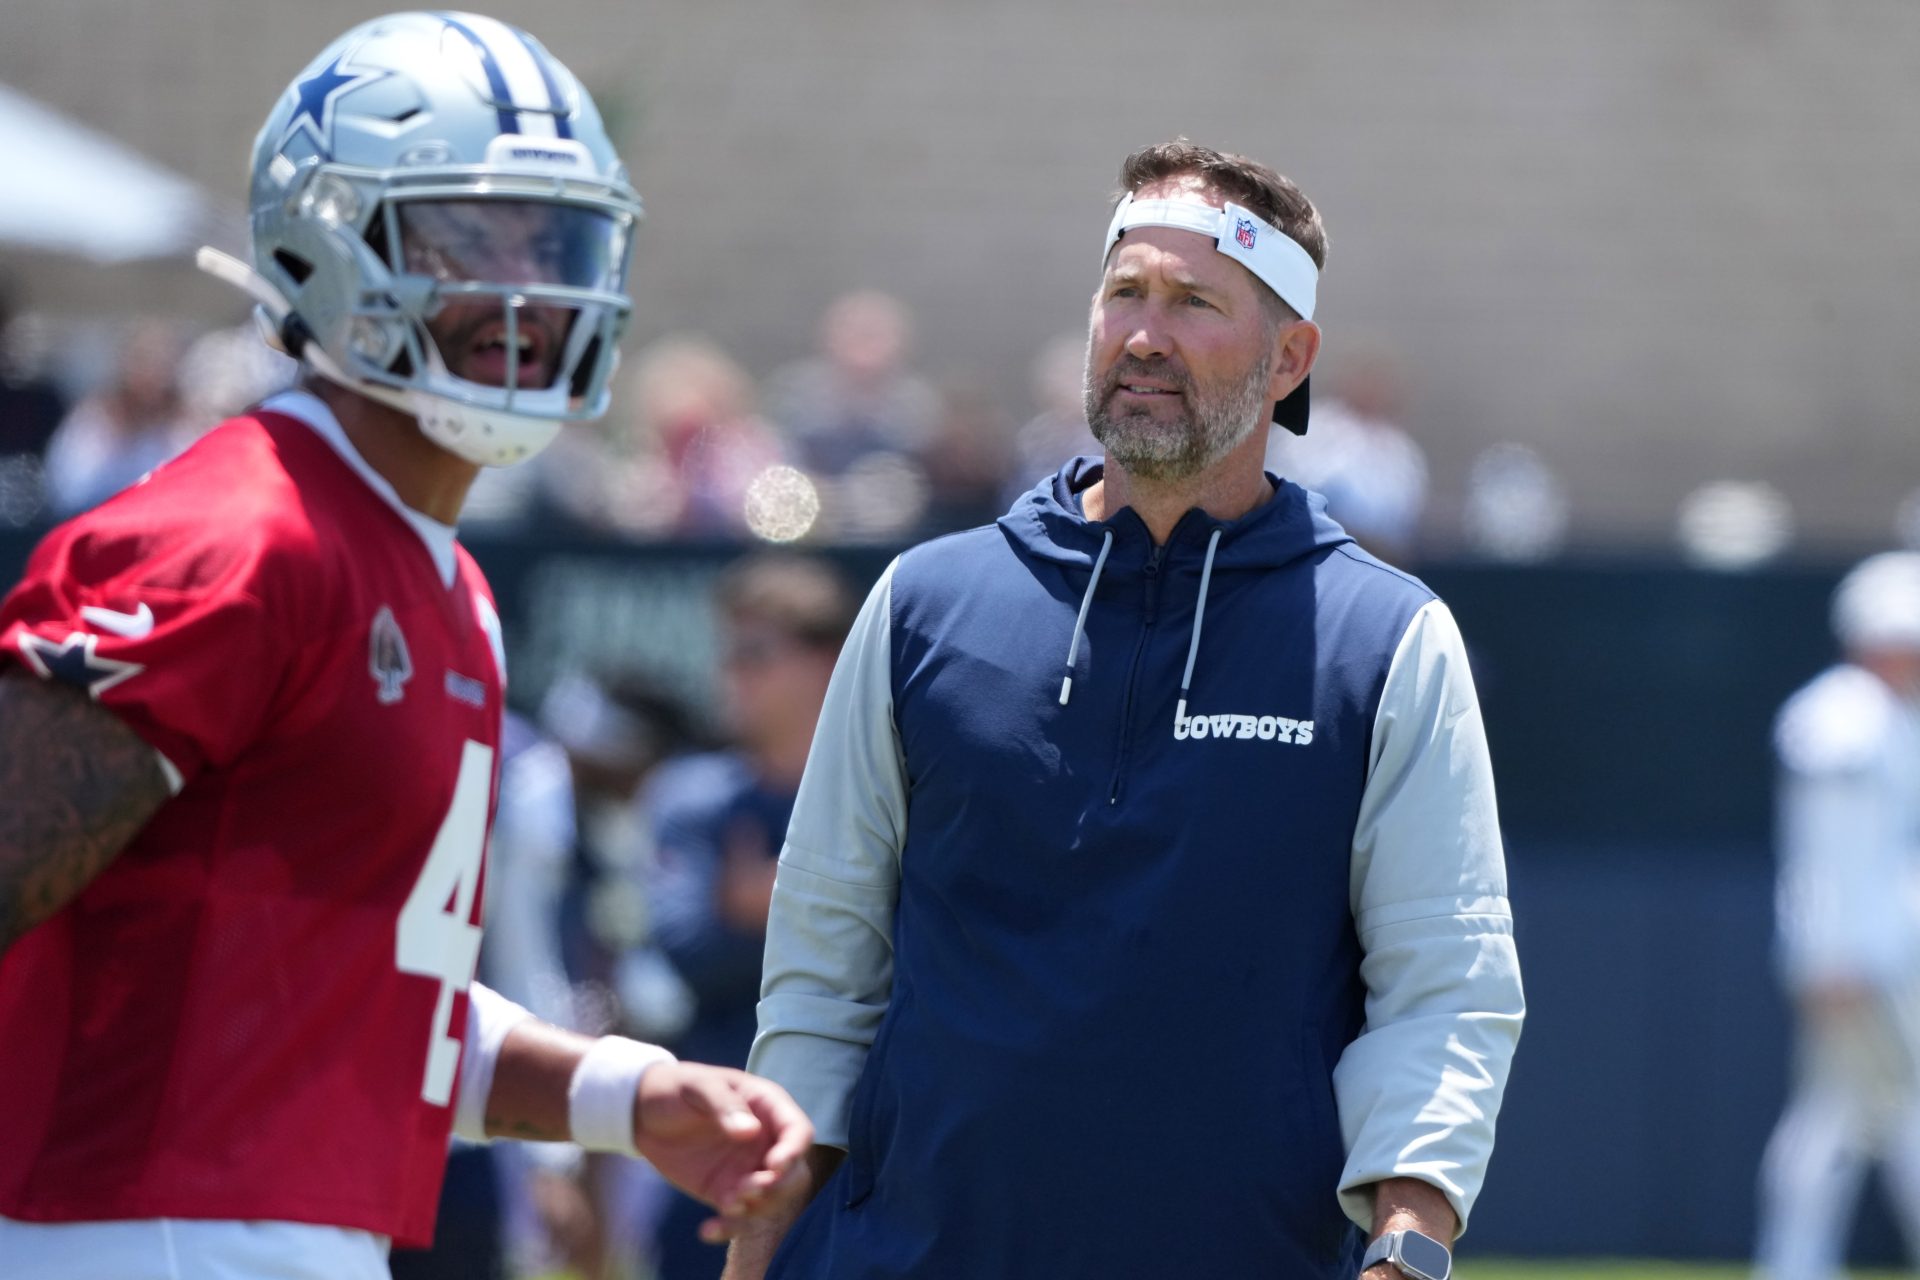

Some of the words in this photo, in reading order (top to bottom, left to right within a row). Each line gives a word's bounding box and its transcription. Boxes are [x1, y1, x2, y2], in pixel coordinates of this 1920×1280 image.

[1237, 228, 1255, 247] NFL
[1174, 714, 1314, 745] COWBOYS
[396, 739, 493, 1106] 4
